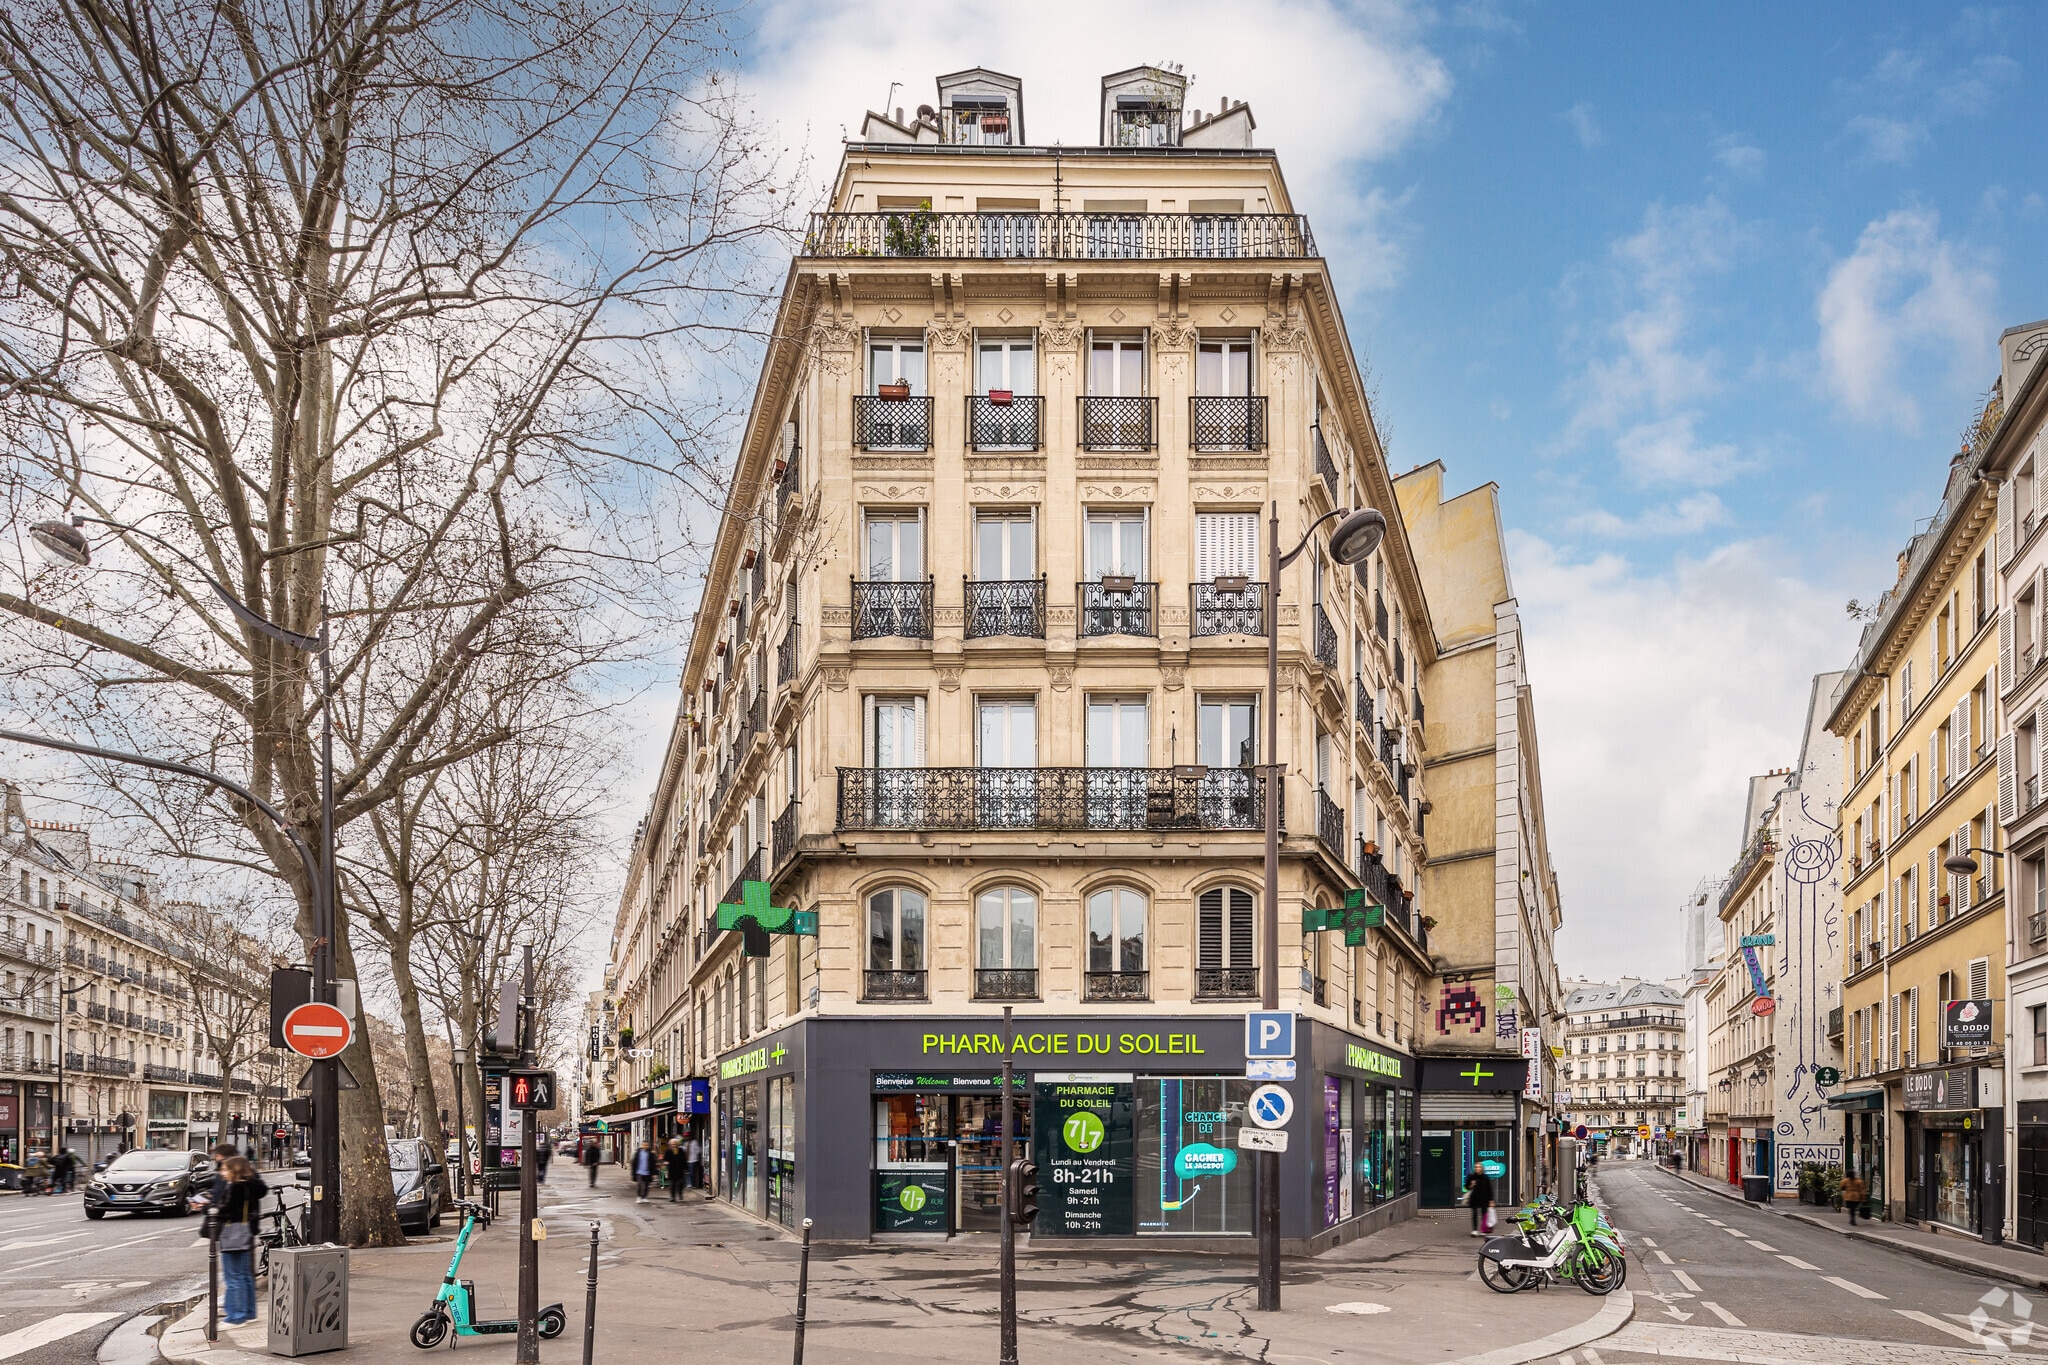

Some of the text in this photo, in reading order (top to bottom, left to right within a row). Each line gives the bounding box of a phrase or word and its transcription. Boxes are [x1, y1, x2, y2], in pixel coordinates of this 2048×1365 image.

[1741, 936, 1775, 947] GRAND
[1745, 948, 1764, 995] HOTEL
[1260, 1020, 1281, 1049] P
[923, 1034, 1205, 1054] PHARMACIE DU SOLEIL
[1523, 1031, 1531, 1055] ALFA
[876, 1077, 914, 1085] Bienvenue
[916, 1076, 949, 1085] Welcome
[953, 1077, 991, 1085] Bienvenue
[1906, 1077, 1914, 1092] LE
[1915, 1074, 1933, 1092] DODO
[1056, 1086, 1115, 1095] PHARMACIE
[1060, 1099, 1112, 1108] DU SOLEIL
[1185, 1111, 1227, 1123] CHANCE
[1199, 1122, 1213, 1134] DE
[1184, 1153, 1225, 1162] GAGNER
[1781, 1148, 1840, 1160] GRAND
[1053, 1168, 1113, 1184] 8h-21h
[1067, 1197, 1100, 1205] 9h -21h
[1065, 1221, 1101, 1229] 10h -21h
[452, 1303, 462, 1323] TIER
